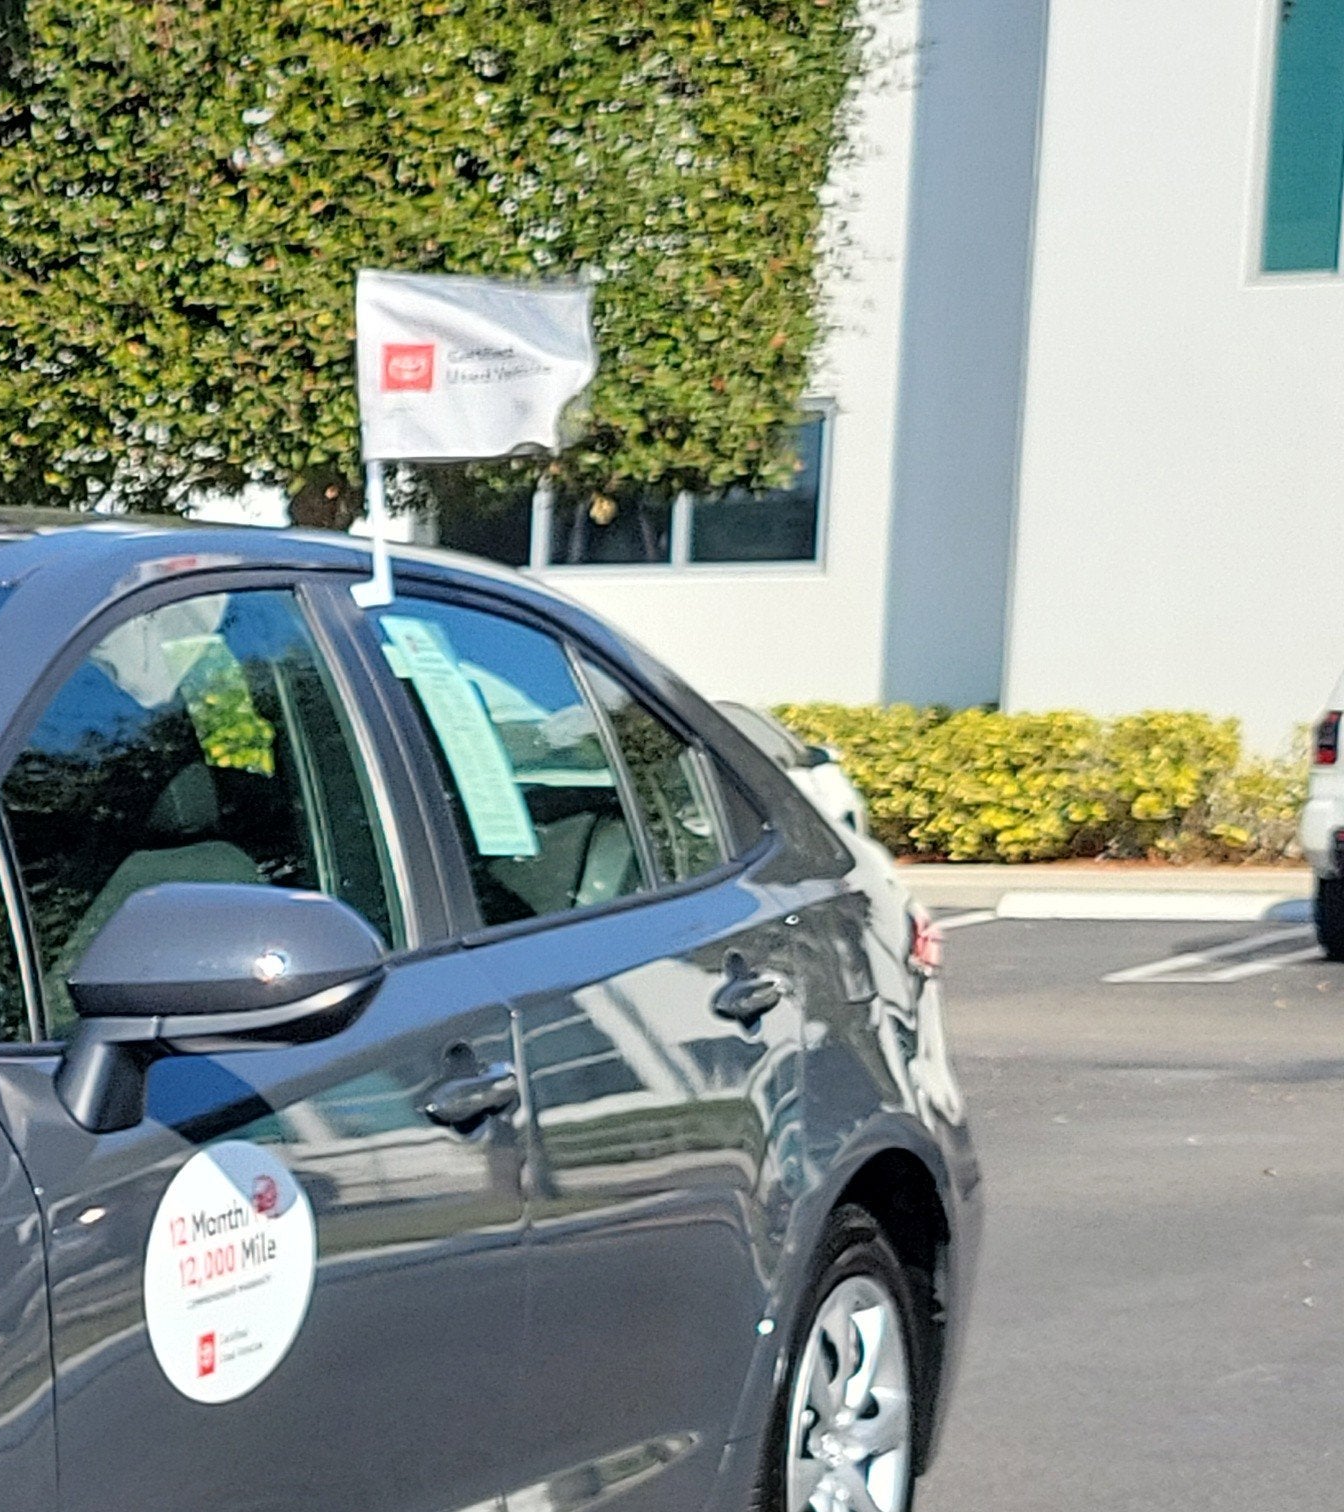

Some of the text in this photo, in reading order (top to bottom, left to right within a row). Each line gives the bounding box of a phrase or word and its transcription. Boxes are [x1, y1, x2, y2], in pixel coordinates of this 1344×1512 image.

[169, 1216, 188, 1249] 12
[179, 1231, 277, 1288] 12,000 Mile
